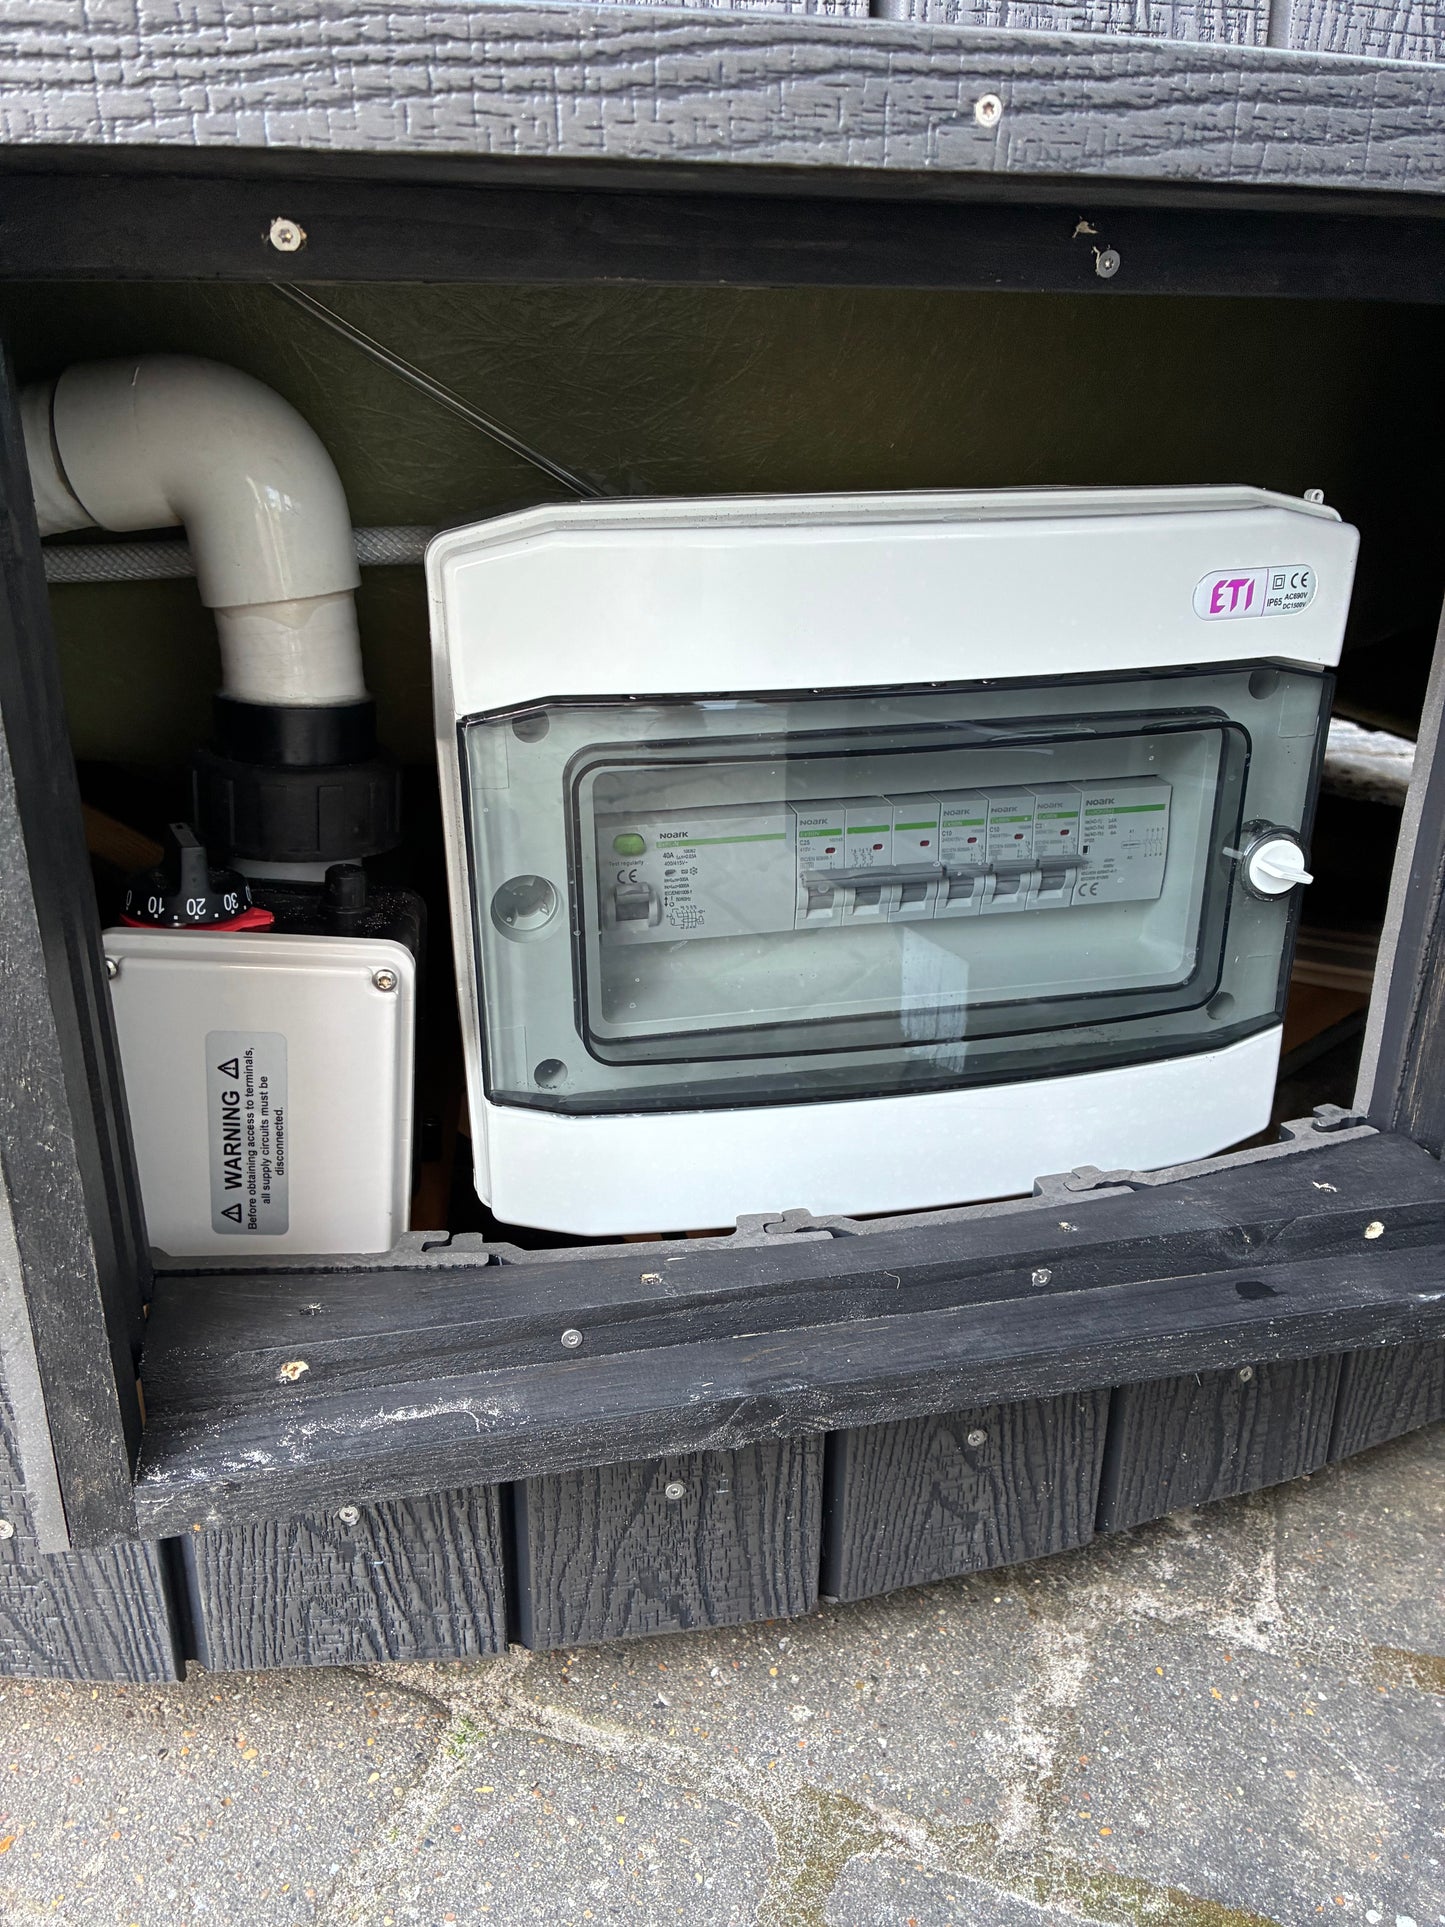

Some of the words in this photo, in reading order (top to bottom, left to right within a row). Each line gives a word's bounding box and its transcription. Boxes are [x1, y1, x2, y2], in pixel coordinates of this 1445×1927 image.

[1209, 578, 1255, 614] ETI
[1266, 597, 1283, 607] IP65
[1282, 601, 1307, 610] DC1500V
[147, 896, 165, 914] 10
[186, 898, 207, 916] 20
[223, 892, 239, 911] 30
[243, 1047, 255, 1098] terminals,
[258, 1075, 268, 1089] be
[244, 1099, 255, 1110] to
[259, 1091, 269, 1116] must
[221, 1090, 243, 1190] WARNING
[246, 1112, 256, 1147] access
[259, 1118, 270, 1156] circuits
[273, 1106, 285, 1176] disconnected.
[246, 1149, 258, 1195] obtaining
[260, 1157, 272, 1191] supply
[247, 1197, 257, 1230] Before
[260, 1193, 271, 1205] all
